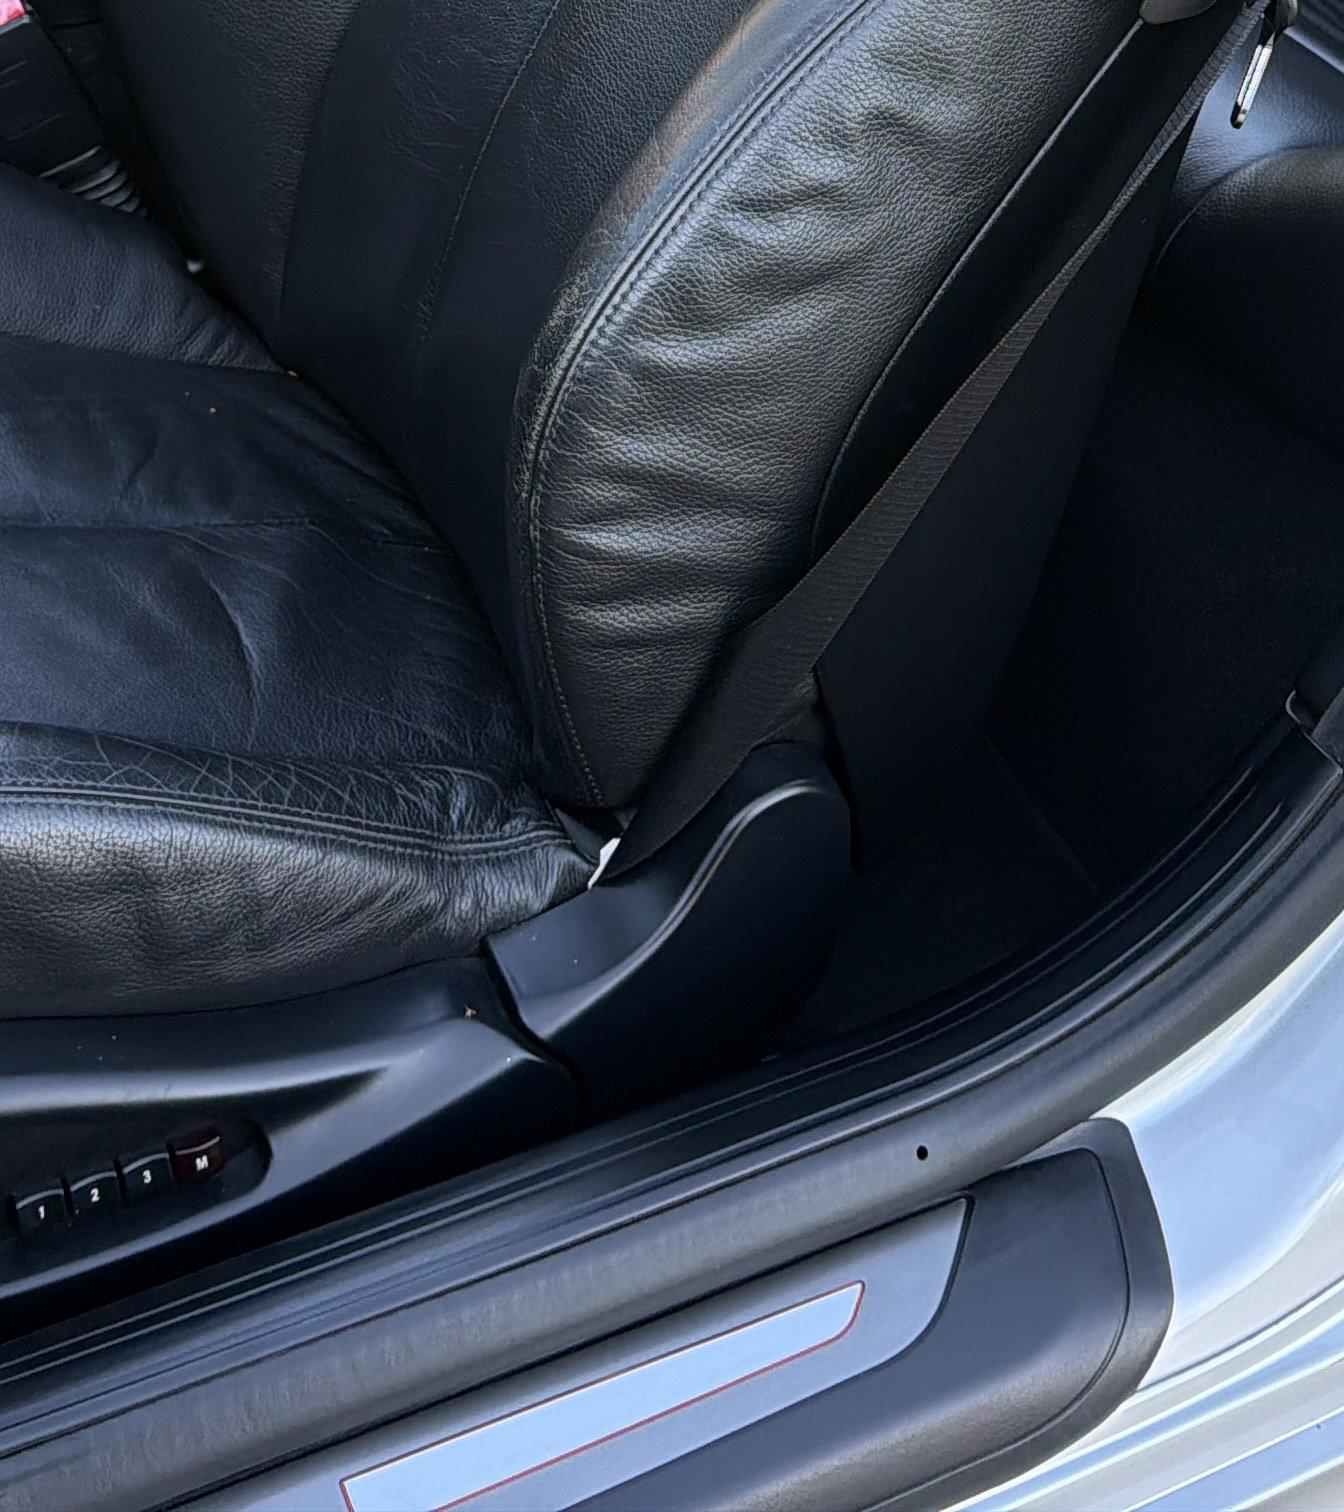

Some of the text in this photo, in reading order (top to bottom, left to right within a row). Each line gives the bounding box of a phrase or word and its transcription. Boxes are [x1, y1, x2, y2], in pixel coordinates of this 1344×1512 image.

[38, 1155, 209, 1220] 1 2 3 M
